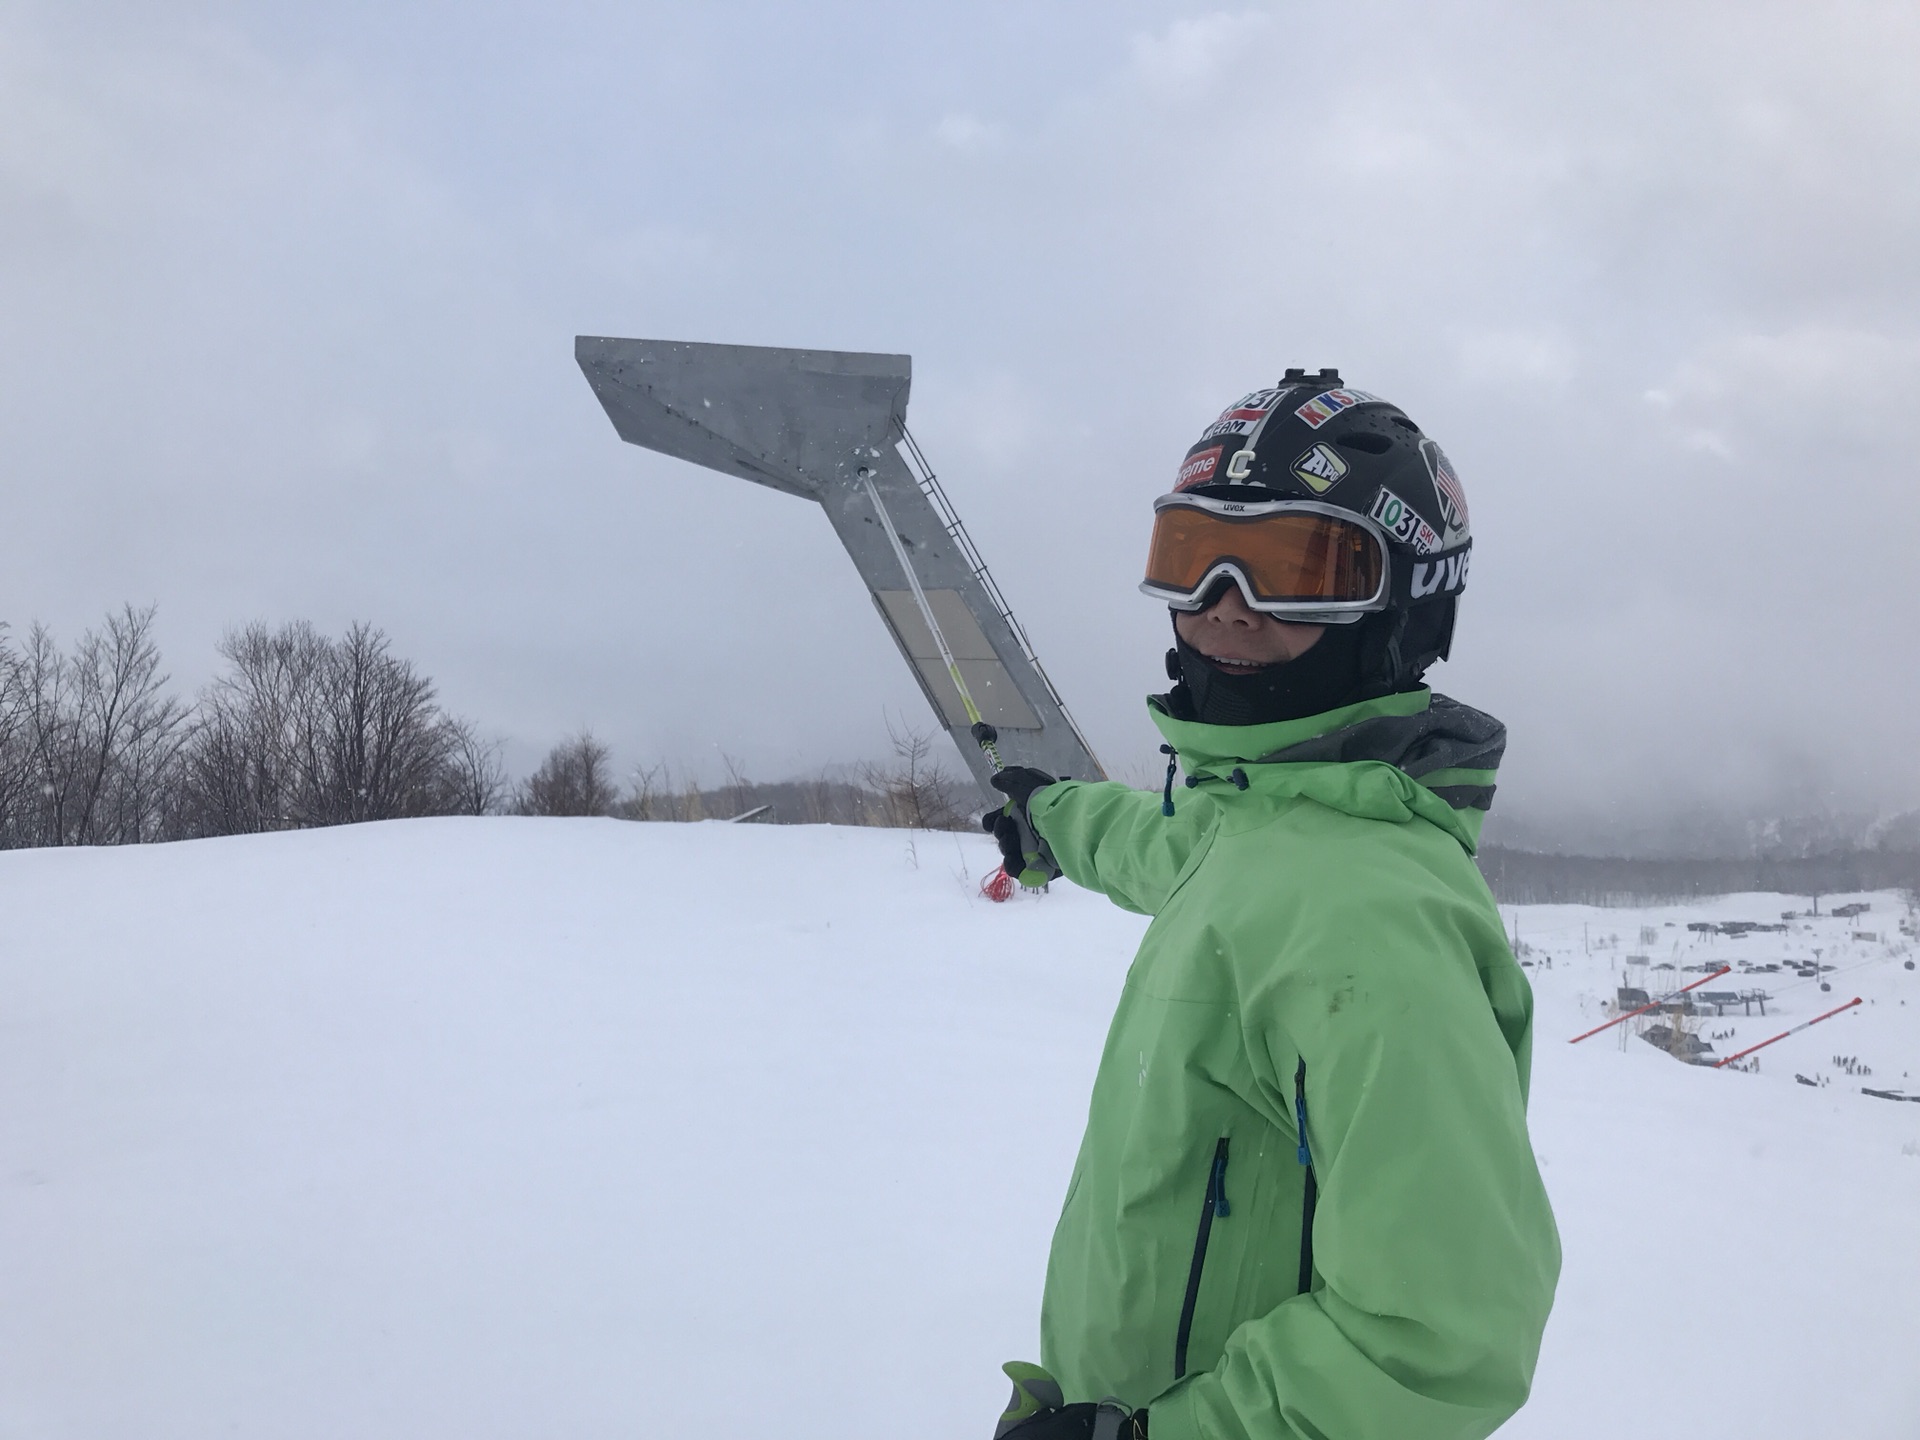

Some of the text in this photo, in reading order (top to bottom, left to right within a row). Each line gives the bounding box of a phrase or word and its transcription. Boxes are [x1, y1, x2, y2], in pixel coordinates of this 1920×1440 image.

[1223, 504, 1245, 512] uvex
[1374, 491, 1421, 542] 1031
[1420, 524, 1435, 547] SKI
